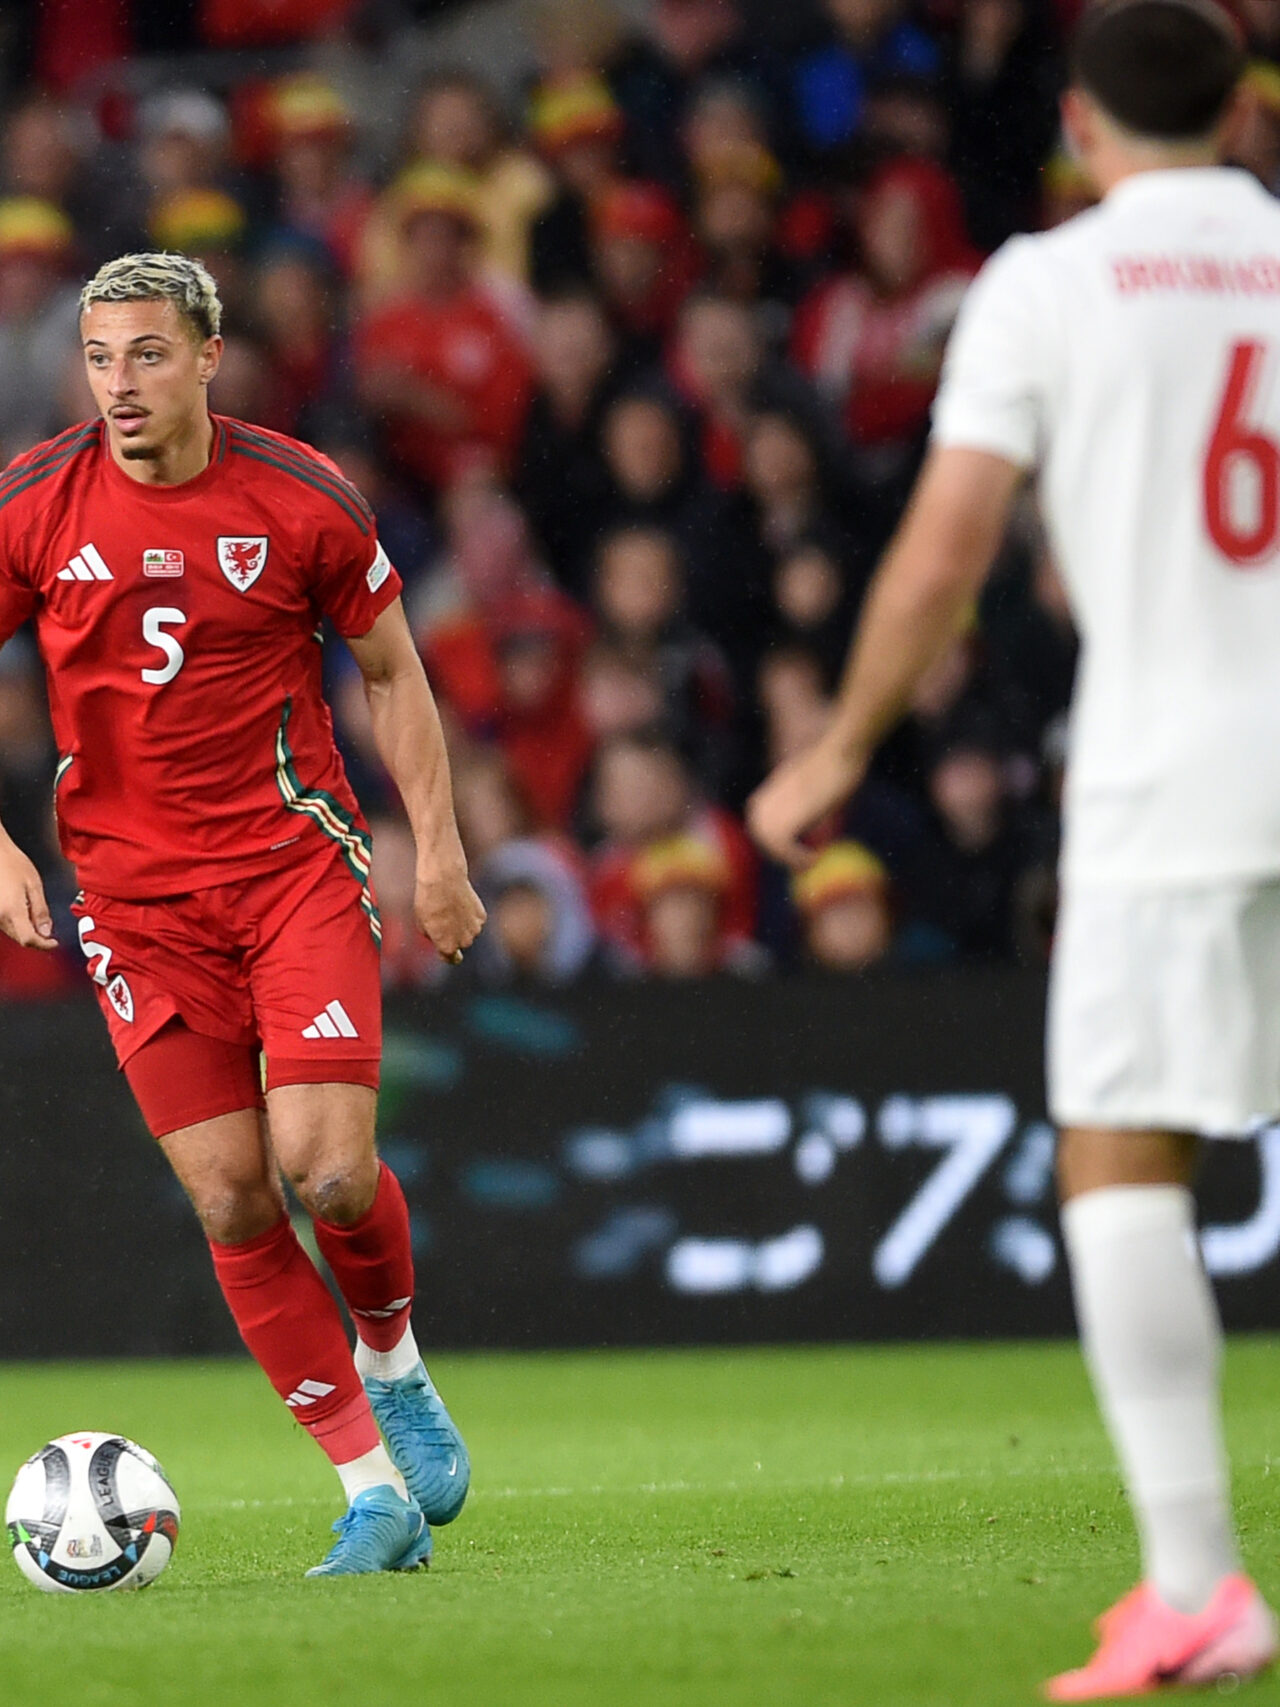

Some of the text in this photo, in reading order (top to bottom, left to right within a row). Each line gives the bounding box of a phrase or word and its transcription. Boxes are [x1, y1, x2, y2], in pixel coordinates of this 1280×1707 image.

[1202, 338, 1280, 566] 6
[141, 607, 187, 685] 5
[77, 915, 113, 986] 5
[96, 1451, 116, 1508] LEAGUE
[59, 1568, 122, 1586] LEAGUE
